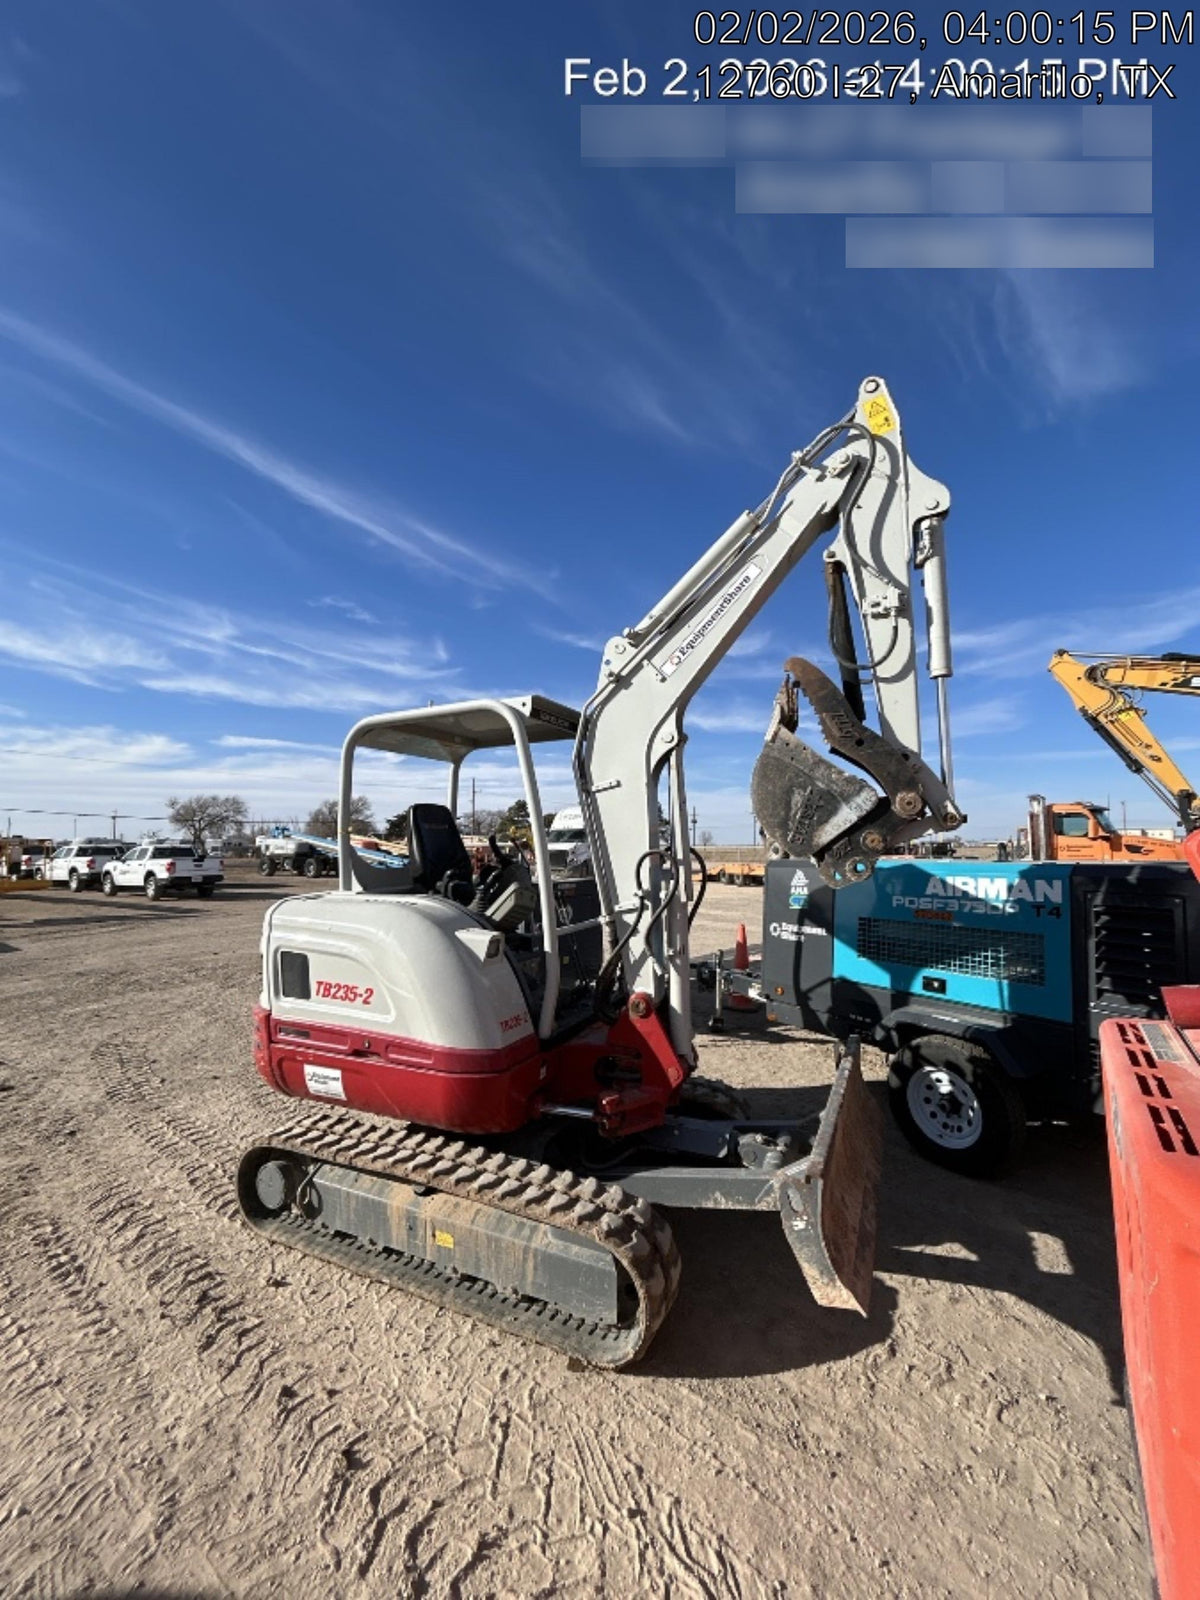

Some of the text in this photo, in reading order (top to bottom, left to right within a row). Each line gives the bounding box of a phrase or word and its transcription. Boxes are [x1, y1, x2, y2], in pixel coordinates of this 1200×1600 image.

[925, 876, 1063, 904] AIRMAN
[1032, 904, 1063, 920] T4
[315, 981, 374, 1005] TB235-2
